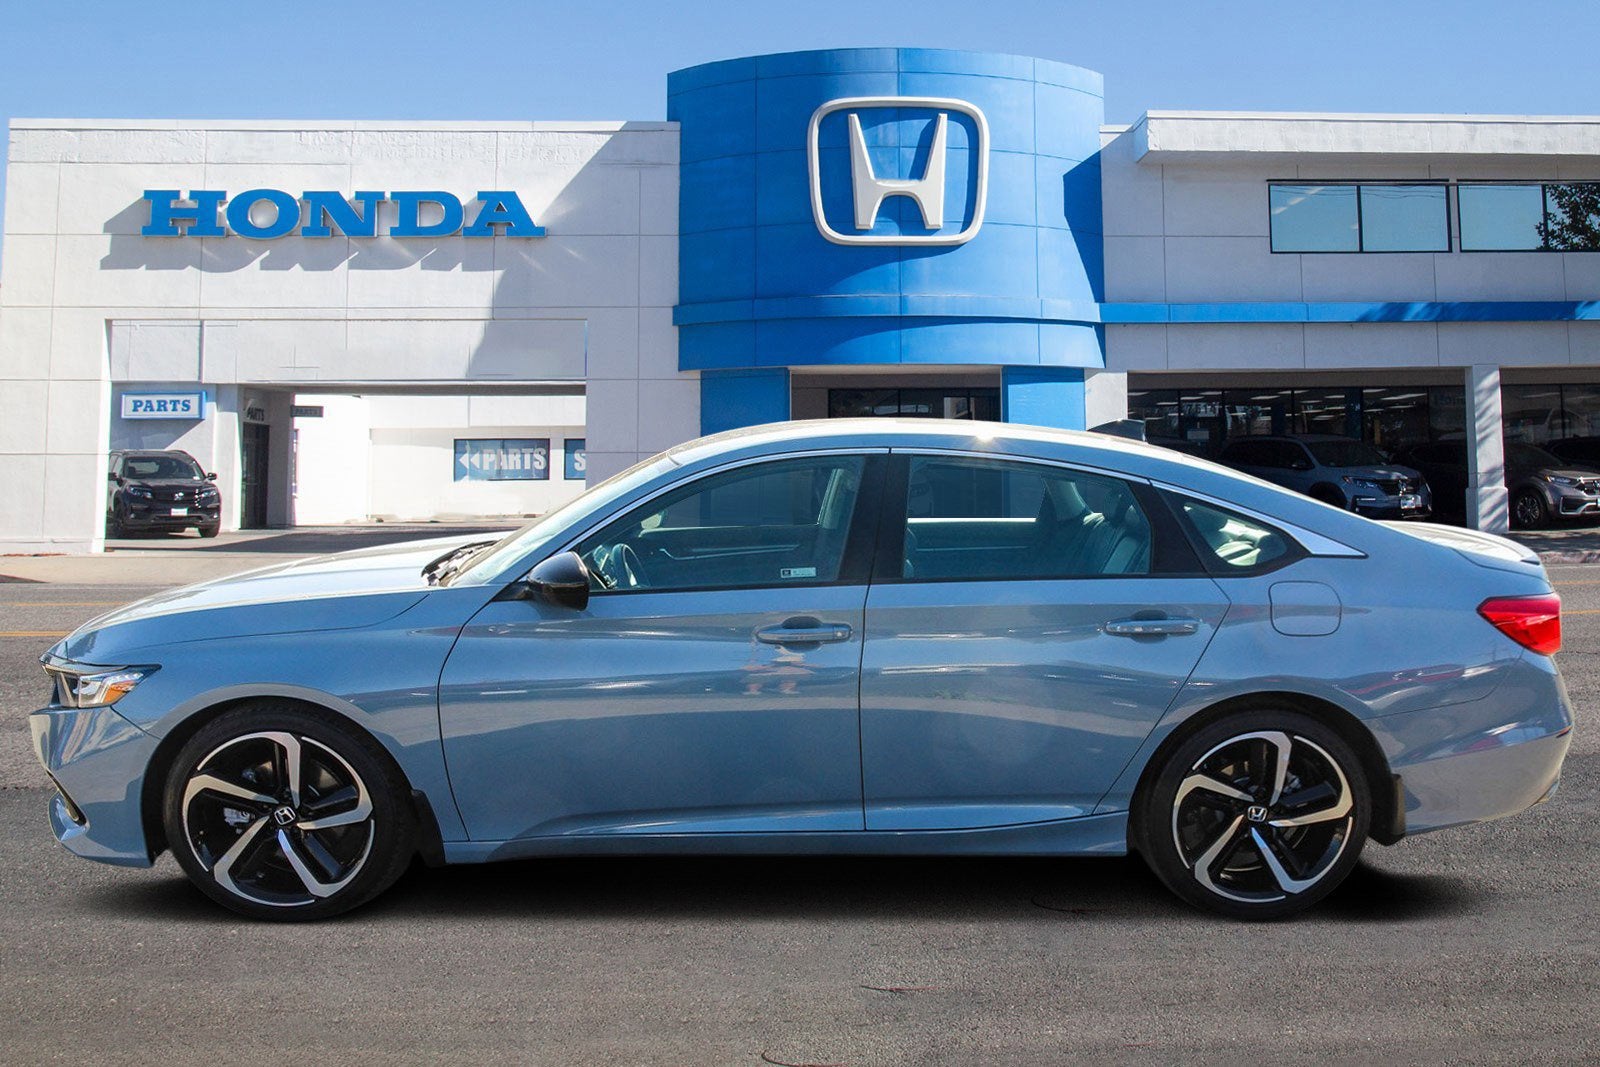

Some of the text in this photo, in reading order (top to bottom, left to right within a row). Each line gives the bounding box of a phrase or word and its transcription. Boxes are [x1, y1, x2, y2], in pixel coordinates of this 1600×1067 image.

[141, 188, 547, 240] HONDA
[131, 399, 192, 413] PARTS
[246, 406, 265, 421] PARTS
[482, 447, 547, 470] PARTS
